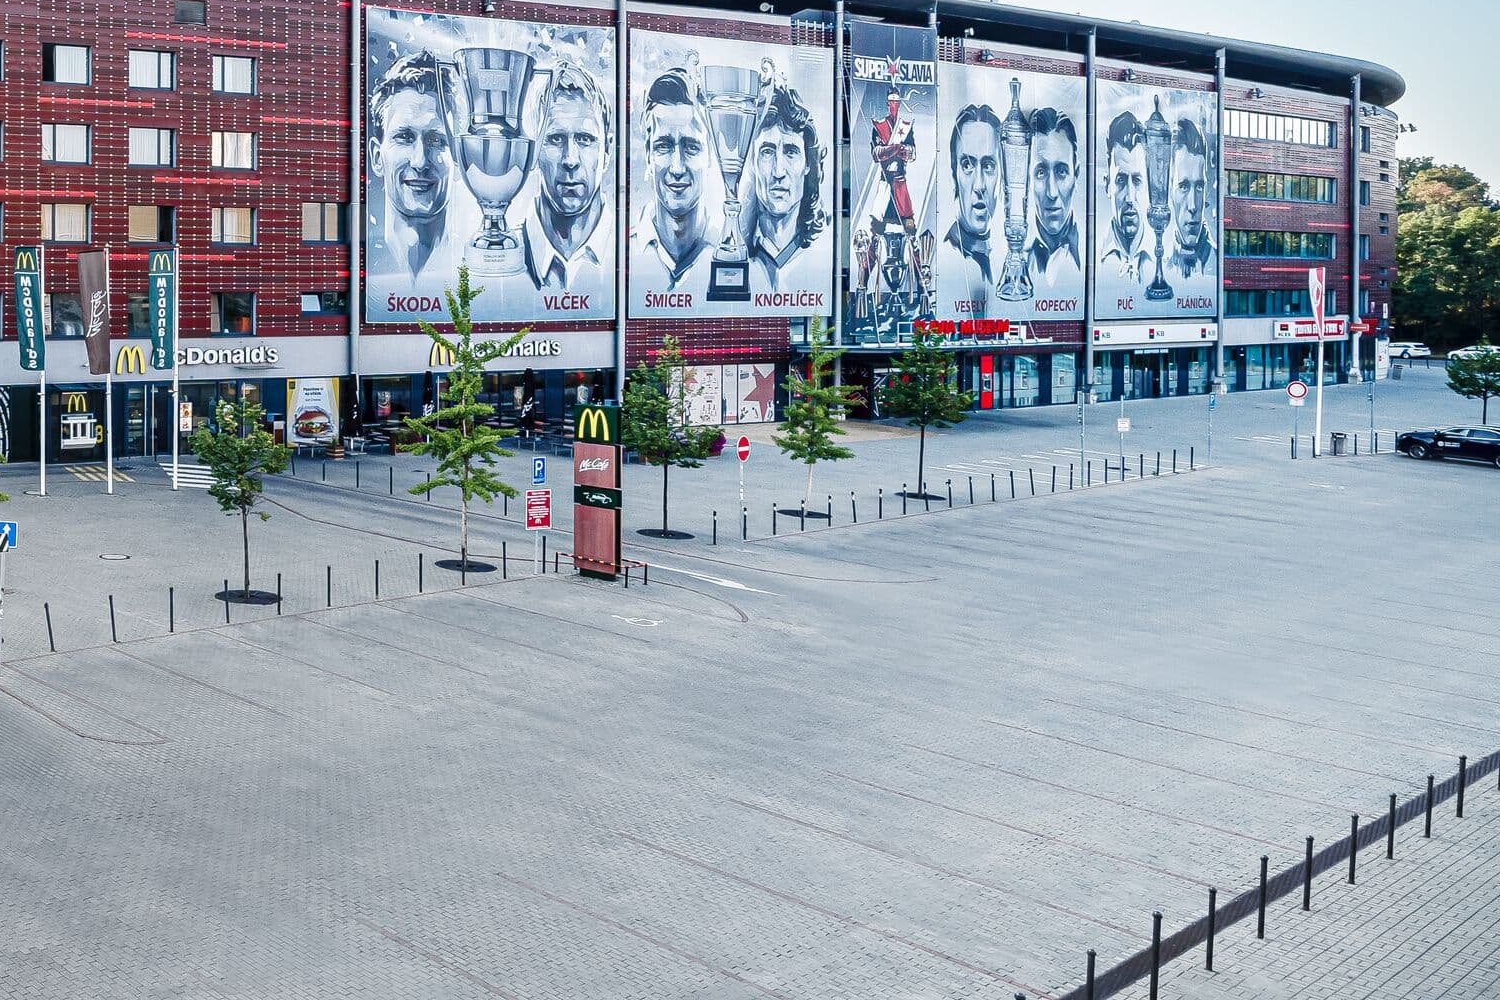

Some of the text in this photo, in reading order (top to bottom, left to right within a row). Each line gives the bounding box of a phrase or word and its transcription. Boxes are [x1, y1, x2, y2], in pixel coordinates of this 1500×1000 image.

[854, 58, 932, 82] SUPER SLAVIA
[387, 292, 590, 312] ŠKODA VLČEK
[645, 289, 823, 308] ŠMICER KNOFLÍČEK
[1035, 297, 1077, 312] KOPECKÝ
[1117, 295, 1213, 310] PUČ PLÁNIČKA
[152, 345, 279, 366] cDonald's
[535, 461, 543, 477] P
